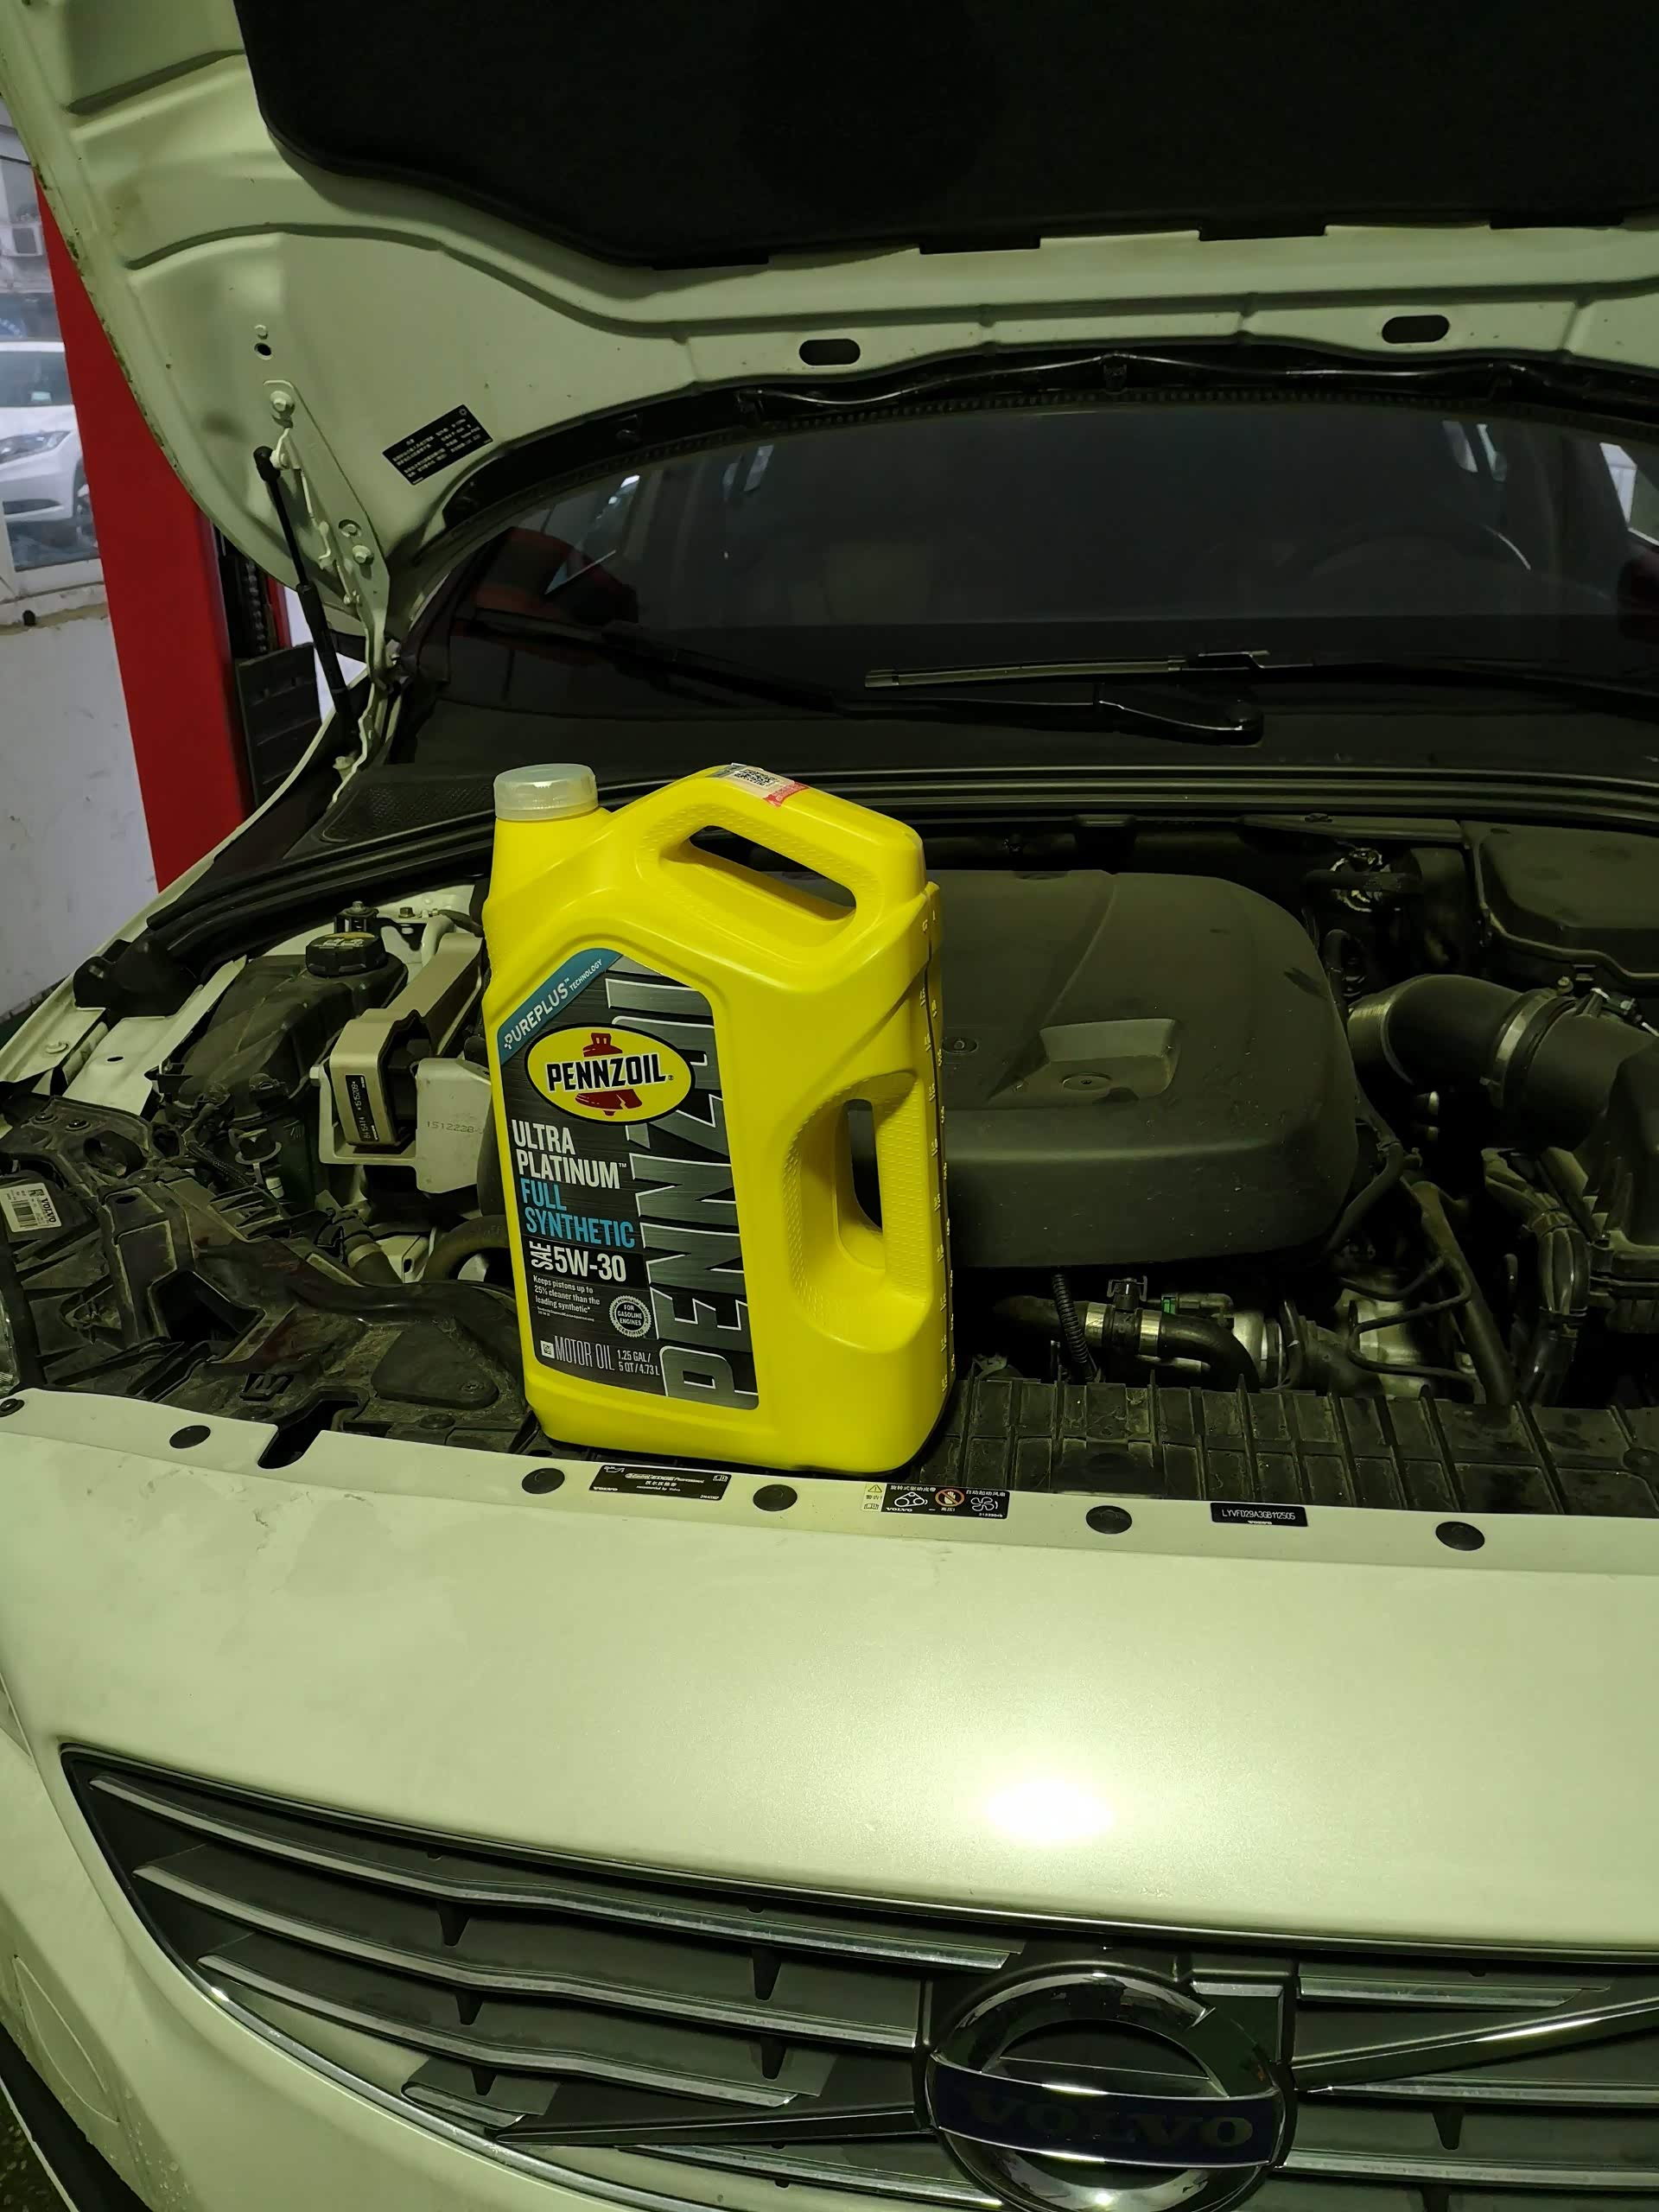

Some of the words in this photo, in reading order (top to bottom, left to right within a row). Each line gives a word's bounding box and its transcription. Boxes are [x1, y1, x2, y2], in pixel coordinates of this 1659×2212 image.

[569, 958, 602, 991] TECHNOLOGY
[512, 1119, 575, 1155] ULTRA
[520, 1178, 567, 1211] FULL
[41, 1198, 56, 1223] VOLVO
[524, 1207, 636, 1249] SYNTHETIC
[529, 1241, 554, 1270] SAE
[554, 1246, 626, 1282] 5W-30
[533, 1274, 551, 1287] Keeps
[552, 1280, 575, 1291] pistons
[576, 1284, 585, 1294] up
[586, 1285, 594, 1294] to
[534, 1285, 548, 1295] 25%
[549, 1289, 572, 1300] cleaner
[572, 1294, 588, 1304] than
[588, 1296, 601, 1306] the
[535, 1295, 557, 1308] leading
[617, 1311, 643, 1319] GASOLINE
[620, 1318, 642, 1326] ENGINES
[555, 1336, 593, 1368] MOTOR
[595, 1343, 615, 1371] OIL
[617, 1349, 632, 1361] 1.25
[619, 1362, 624, 1372] 5
[956, 2088, 1254, 2148] VOLVO
